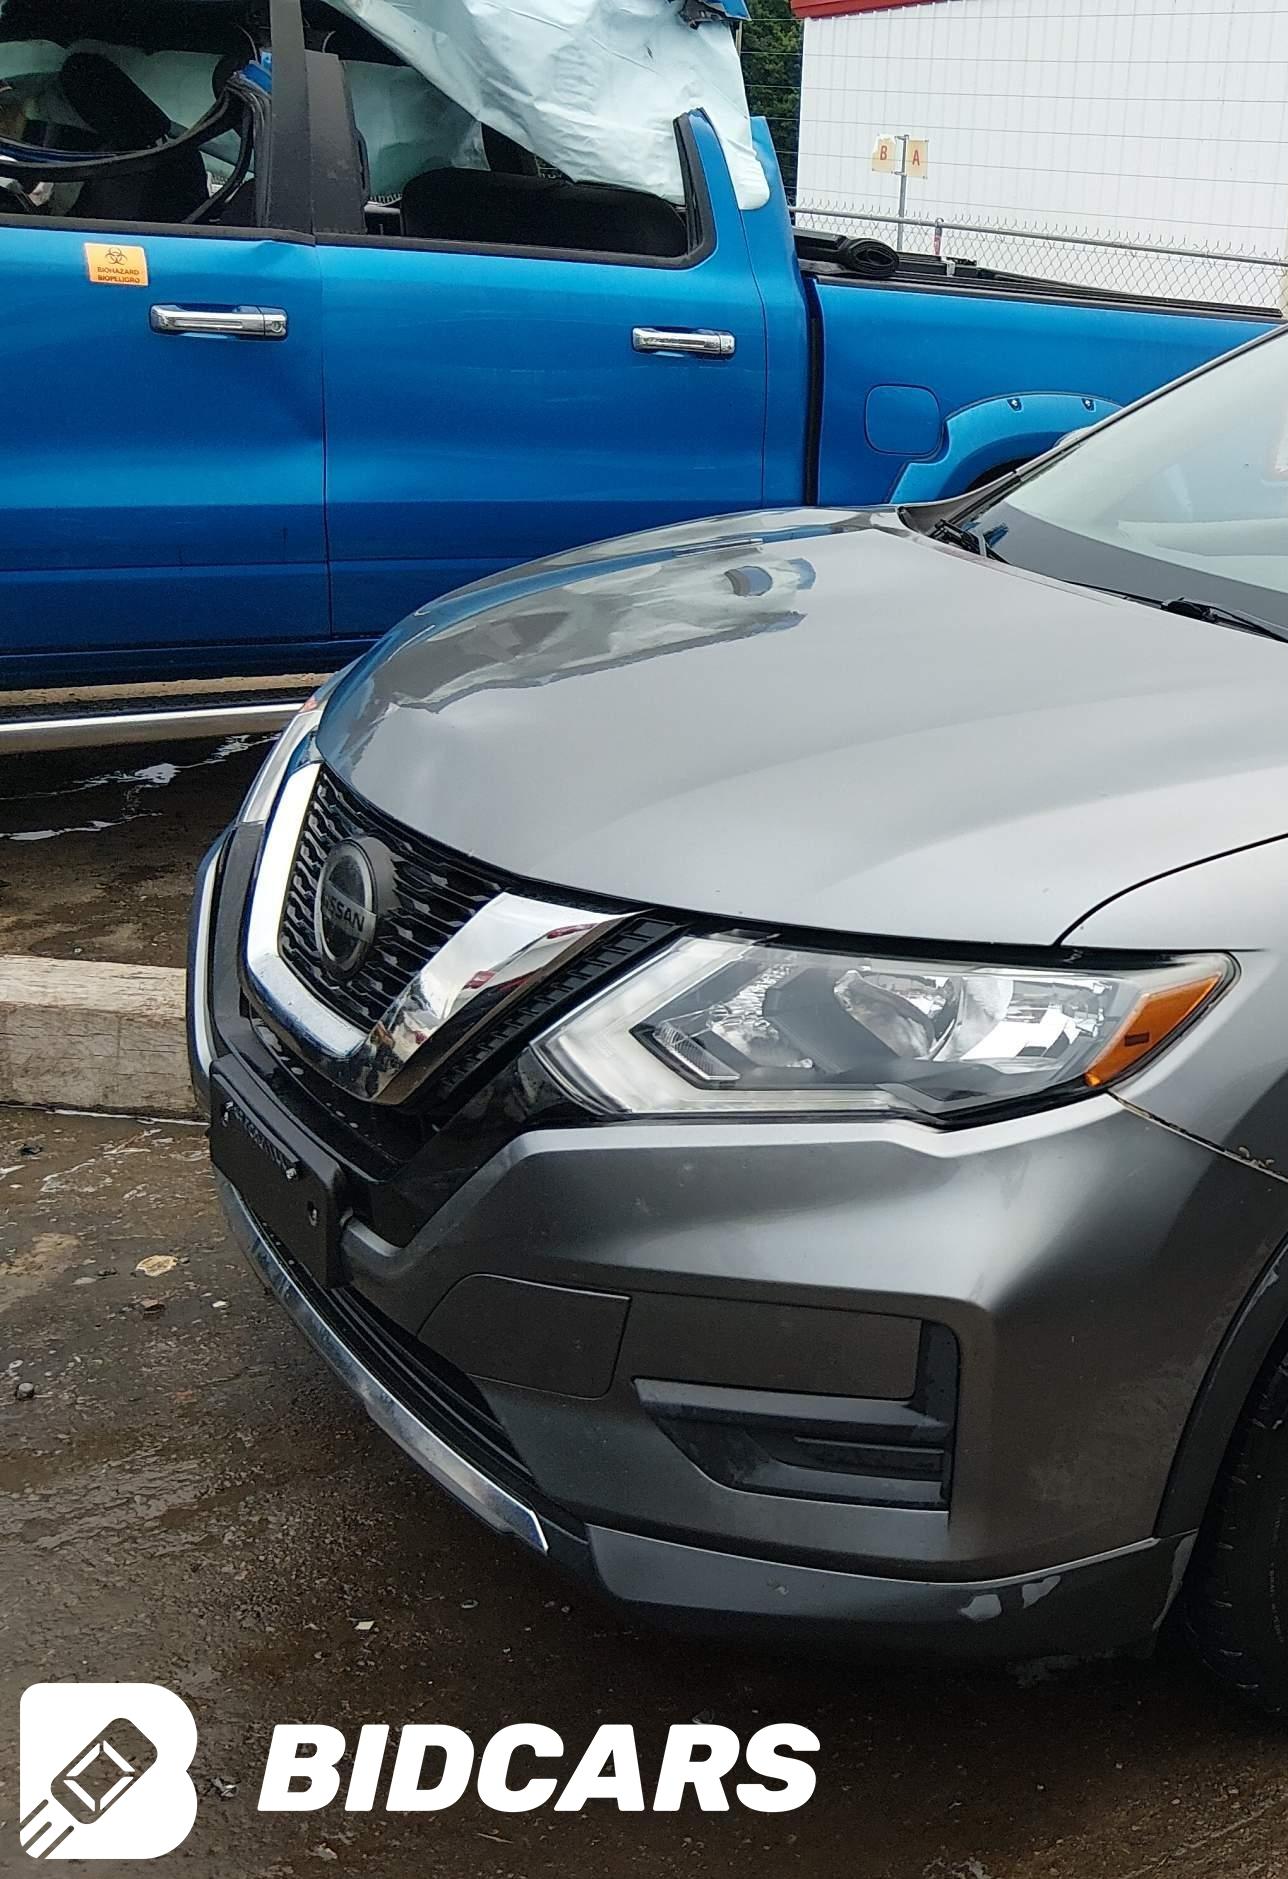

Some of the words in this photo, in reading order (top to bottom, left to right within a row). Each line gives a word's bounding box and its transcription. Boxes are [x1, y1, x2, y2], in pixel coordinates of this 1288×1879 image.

[880, 145, 887, 160] B
[912, 149, 920, 166] A
[97, 266, 140, 275] BIOHAZARD
[97, 275, 141, 284] BIOPELIGRO
[324, 894, 365, 933] NISSAN
